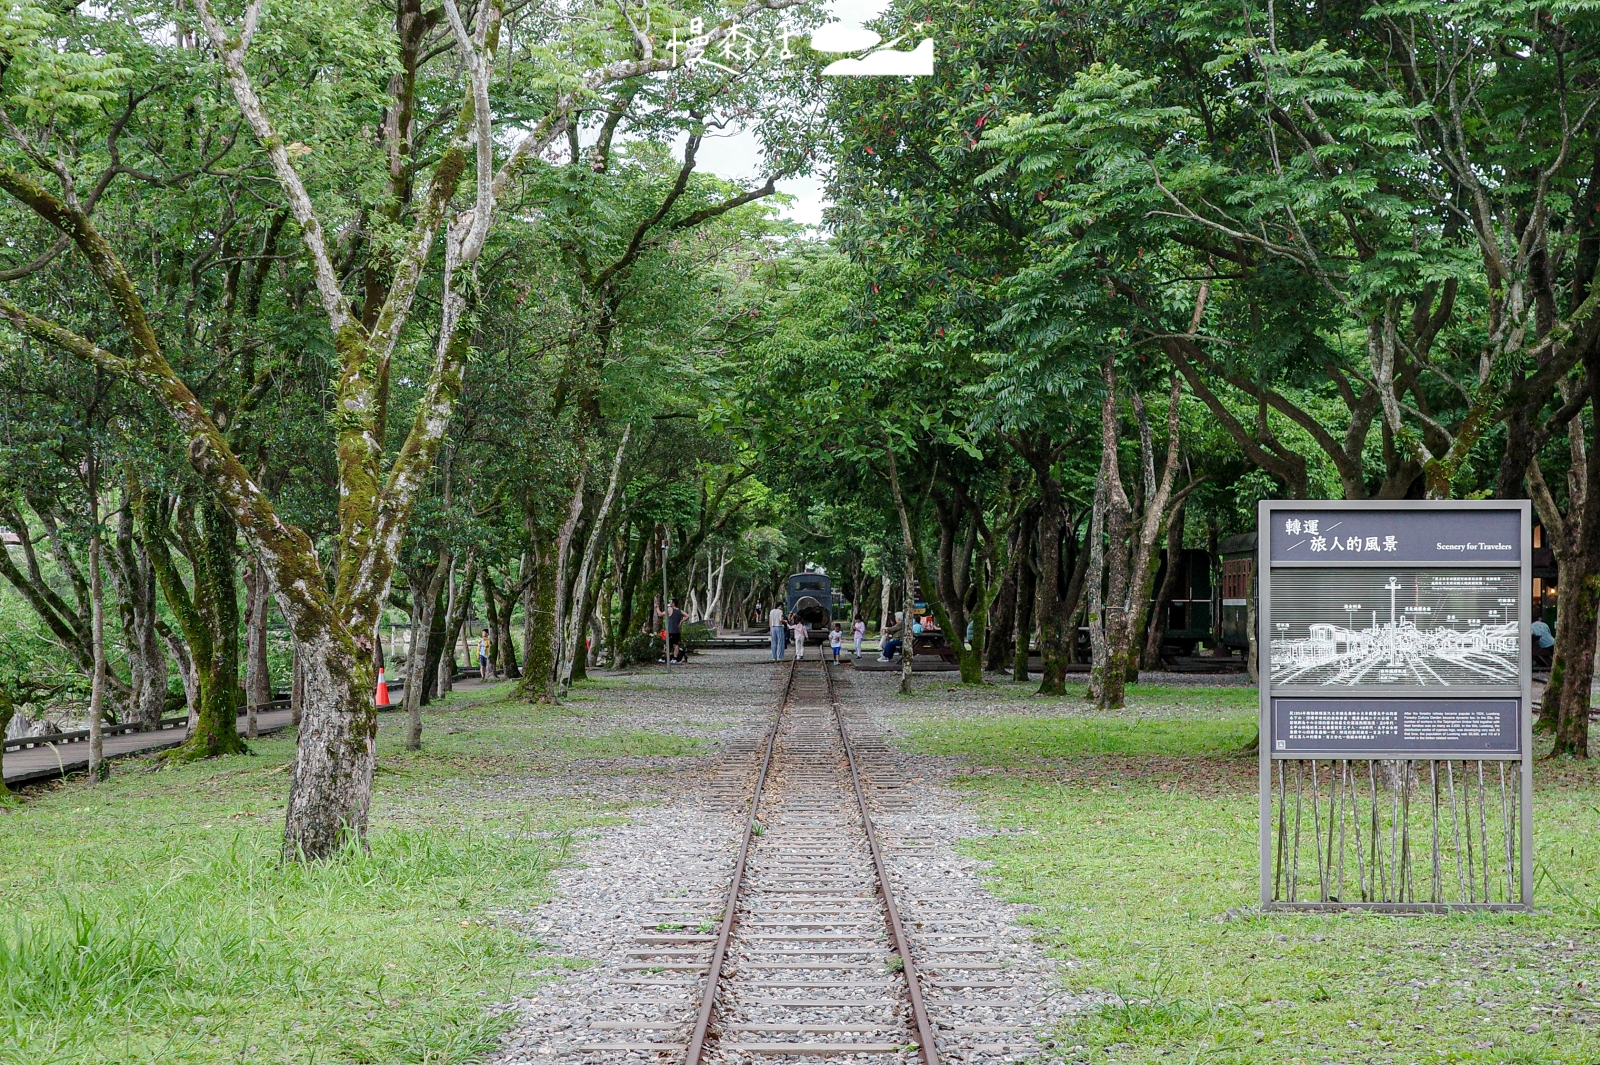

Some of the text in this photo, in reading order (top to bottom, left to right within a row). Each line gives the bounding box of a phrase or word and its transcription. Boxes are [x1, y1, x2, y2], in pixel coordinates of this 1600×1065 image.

[1285, 518, 1320, 536] 轉運
[1310, 535, 1399, 553] 旅人的風景
[1436, 542, 1512, 552] Scenery for Travelers
